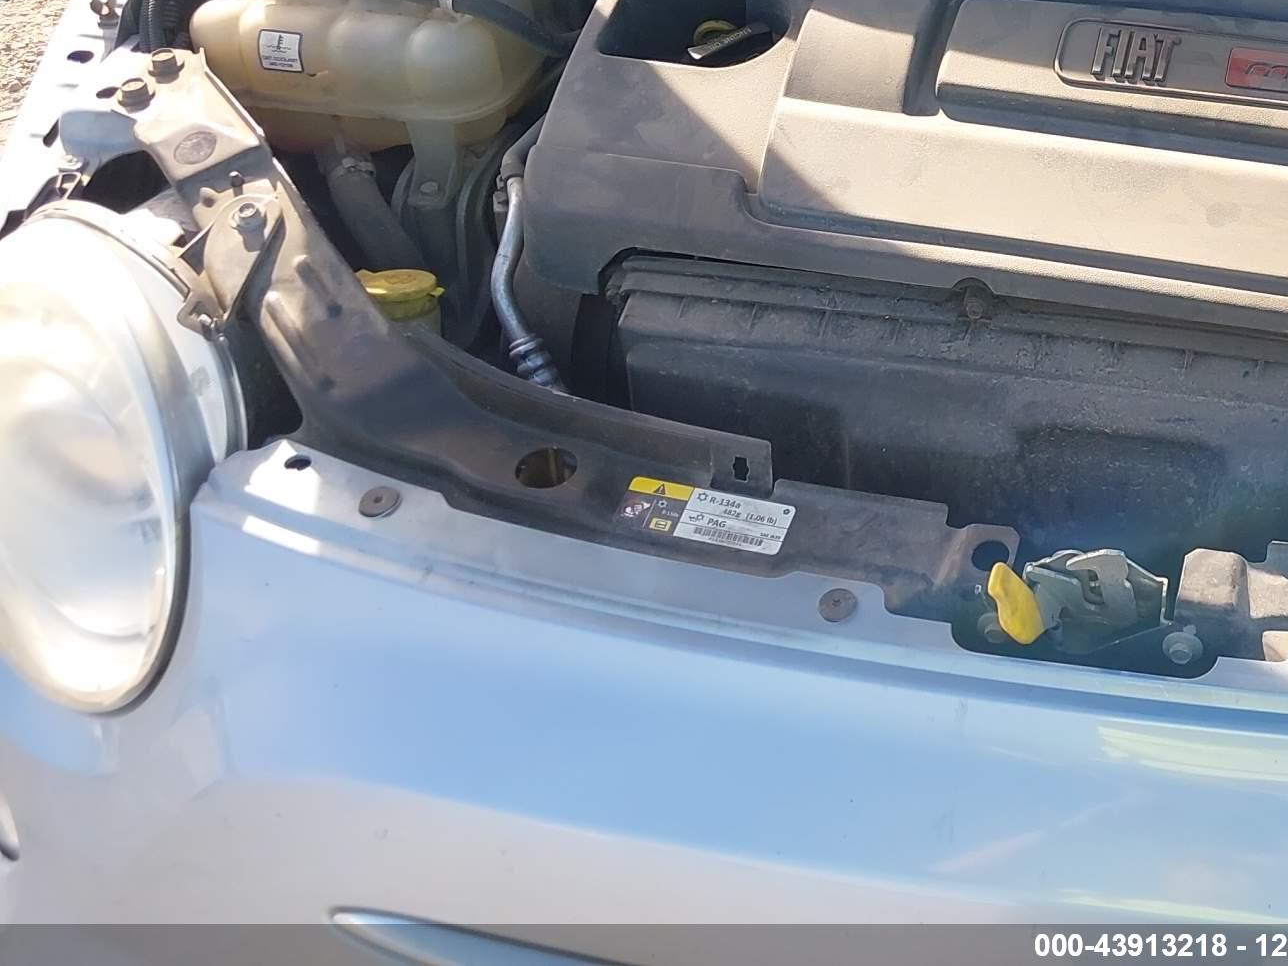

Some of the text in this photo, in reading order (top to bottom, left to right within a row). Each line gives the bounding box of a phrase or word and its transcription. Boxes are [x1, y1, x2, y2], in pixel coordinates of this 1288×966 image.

[1090, 27, 1183, 88] FIAT
[709, 496, 741, 509] R-134a
[706, 518, 728, 529] PAG
[766, 513, 778, 525] lb)
